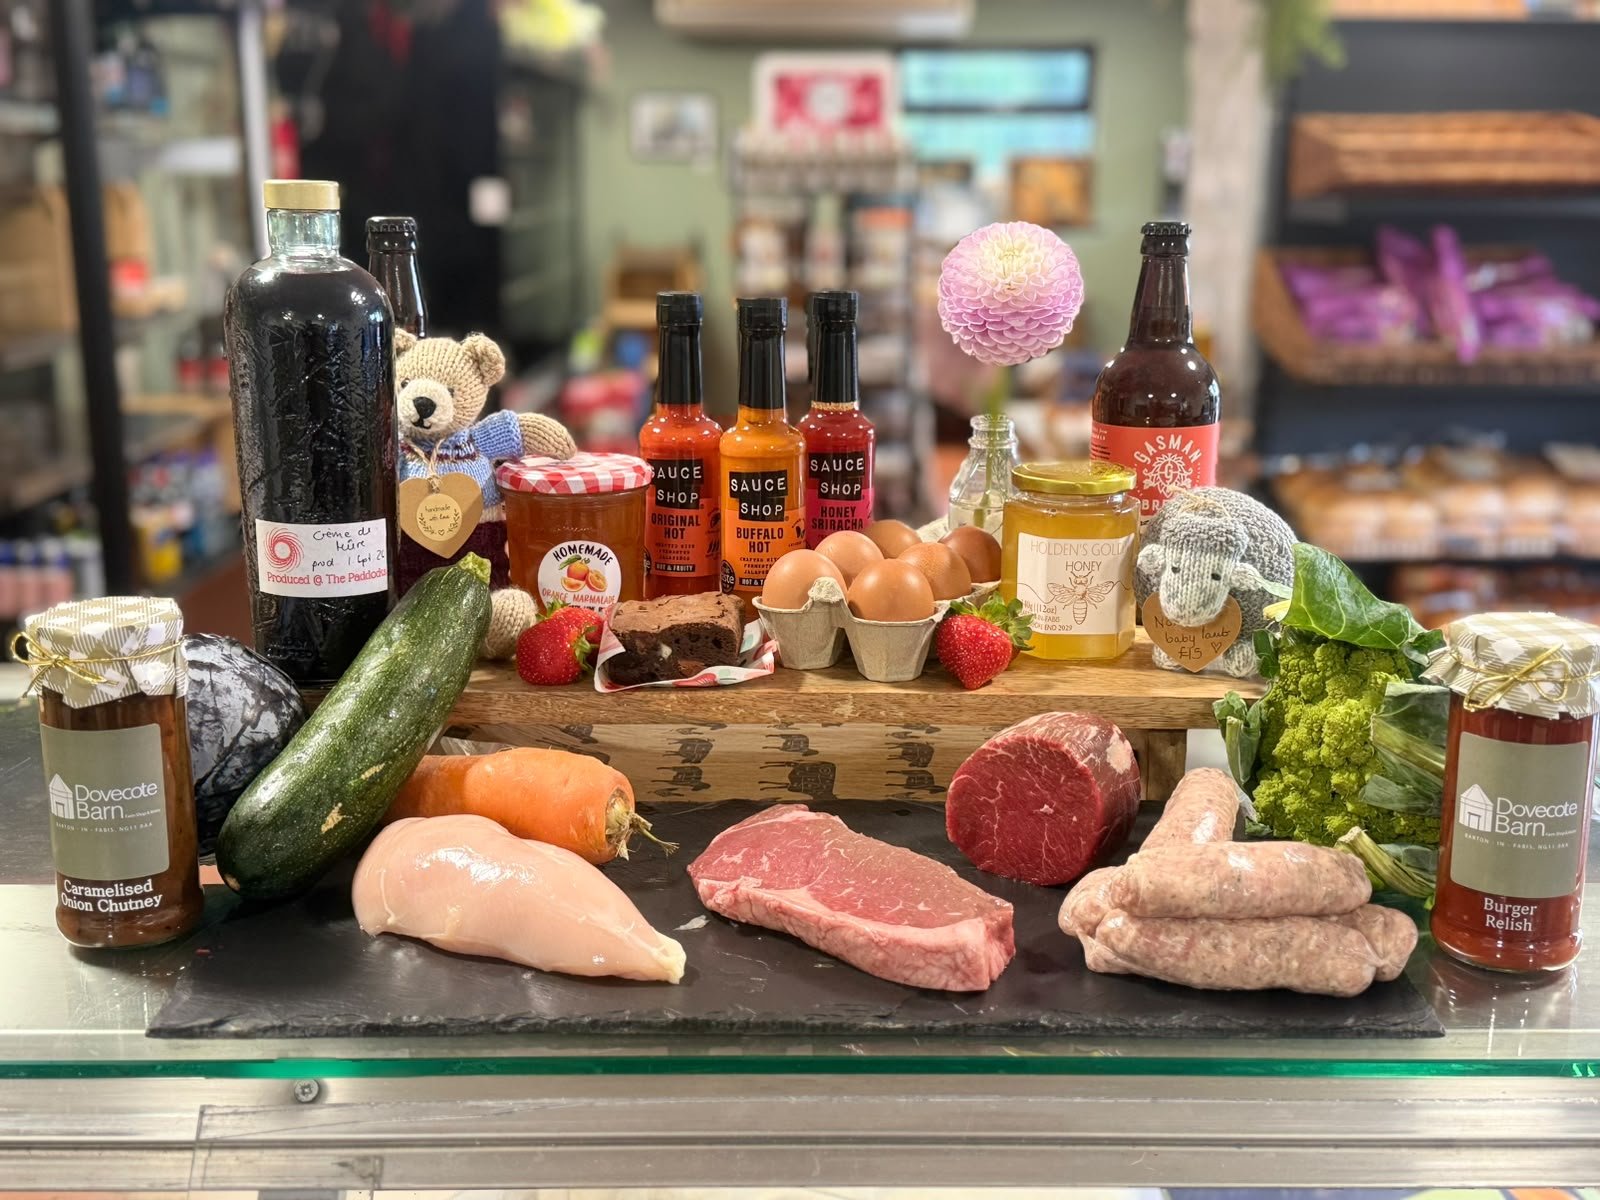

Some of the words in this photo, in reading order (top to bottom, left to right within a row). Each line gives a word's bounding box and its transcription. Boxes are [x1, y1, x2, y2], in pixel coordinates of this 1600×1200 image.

[1134, 434, 1202, 464] GASMAN
[810, 457, 864, 472] SAUCE
[731, 477, 786, 492] SAUCE
[820, 482, 861, 495] SHOP
[657, 489, 699, 503] SHOP
[741, 502, 783, 516] SHOP
[821, 506, 856, 518] HONEY
[651, 513, 701, 527] ORIGINAL
[811, 517, 864, 531] SRIRACHA
[664, 527, 685, 540] HOT
[736, 527, 784, 540] BUFFALO
[749, 541, 770, 553] HOT
[1030, 540, 1088, 556] HOLDEN'S
[1091, 542, 1124, 556] GOLD
[552, 544, 613, 566] HOMEMADE
[312, 558, 334, 572] prod
[1065, 560, 1102, 572] HONEY
[267, 571, 310, 585] Produced
[313, 575, 323, 586] @
[326, 574, 346, 584] The
[542, 587, 569, 602] ORANGE
[573, 594, 616, 605] MARMALADE
[1165, 632, 1196, 649] baby
[1178, 646, 1203, 660] £15
[75, 782, 158, 802] Dovecote
[76, 801, 124, 820] Barn
[1496, 796, 1578, 818] Dovecote
[1495, 814, 1545, 836] Barn
[1464, 833, 1489, 844] BARTON
[63, 878, 153, 898] Caramelised
[61, 893, 93, 912] Onion
[97, 893, 163, 913] Chutney
[1483, 897, 1537, 918] Burger
[1485, 914, 1533, 932] Relish
